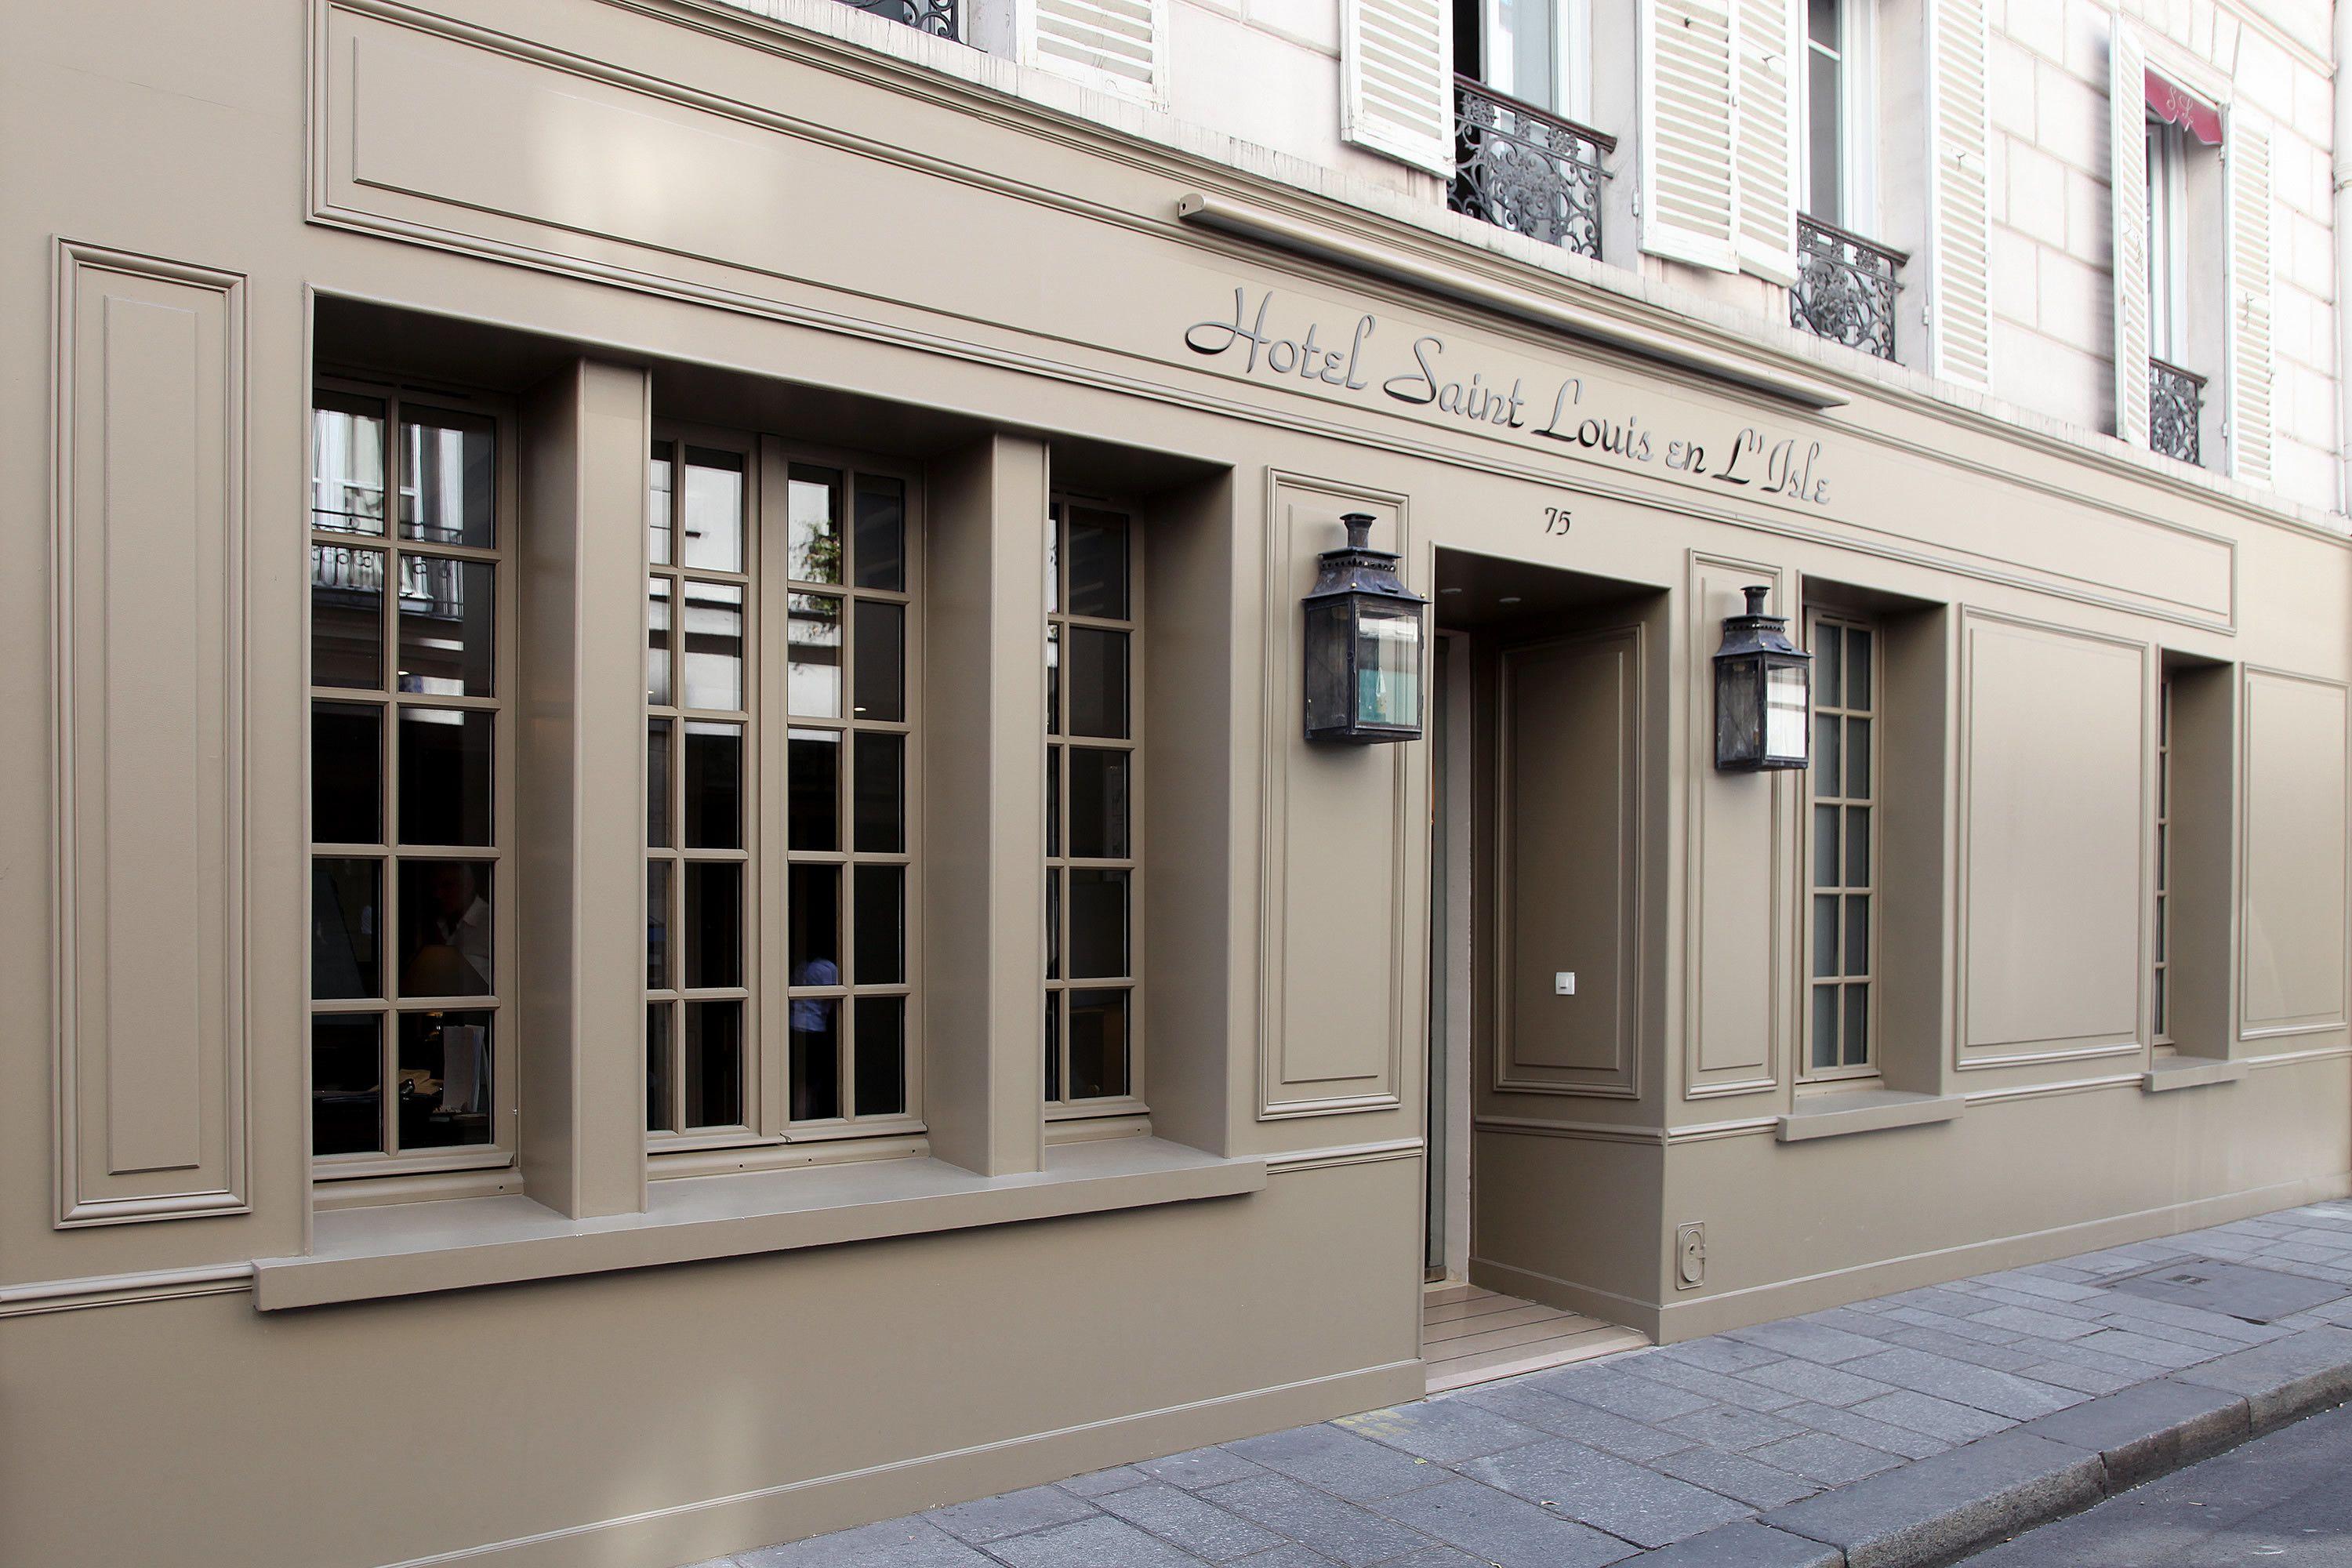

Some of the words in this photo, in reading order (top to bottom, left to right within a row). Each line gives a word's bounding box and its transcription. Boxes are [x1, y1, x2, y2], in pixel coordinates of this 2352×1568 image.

[1184, 286, 1377, 390] Hotel
[1382, 334, 1525, 429] Saint
[1530, 377, 1655, 463] Louis
[1664, 440, 1708, 474] en
[1711, 426, 1832, 506] L'Isle
[1544, 506, 1572, 536] 75
